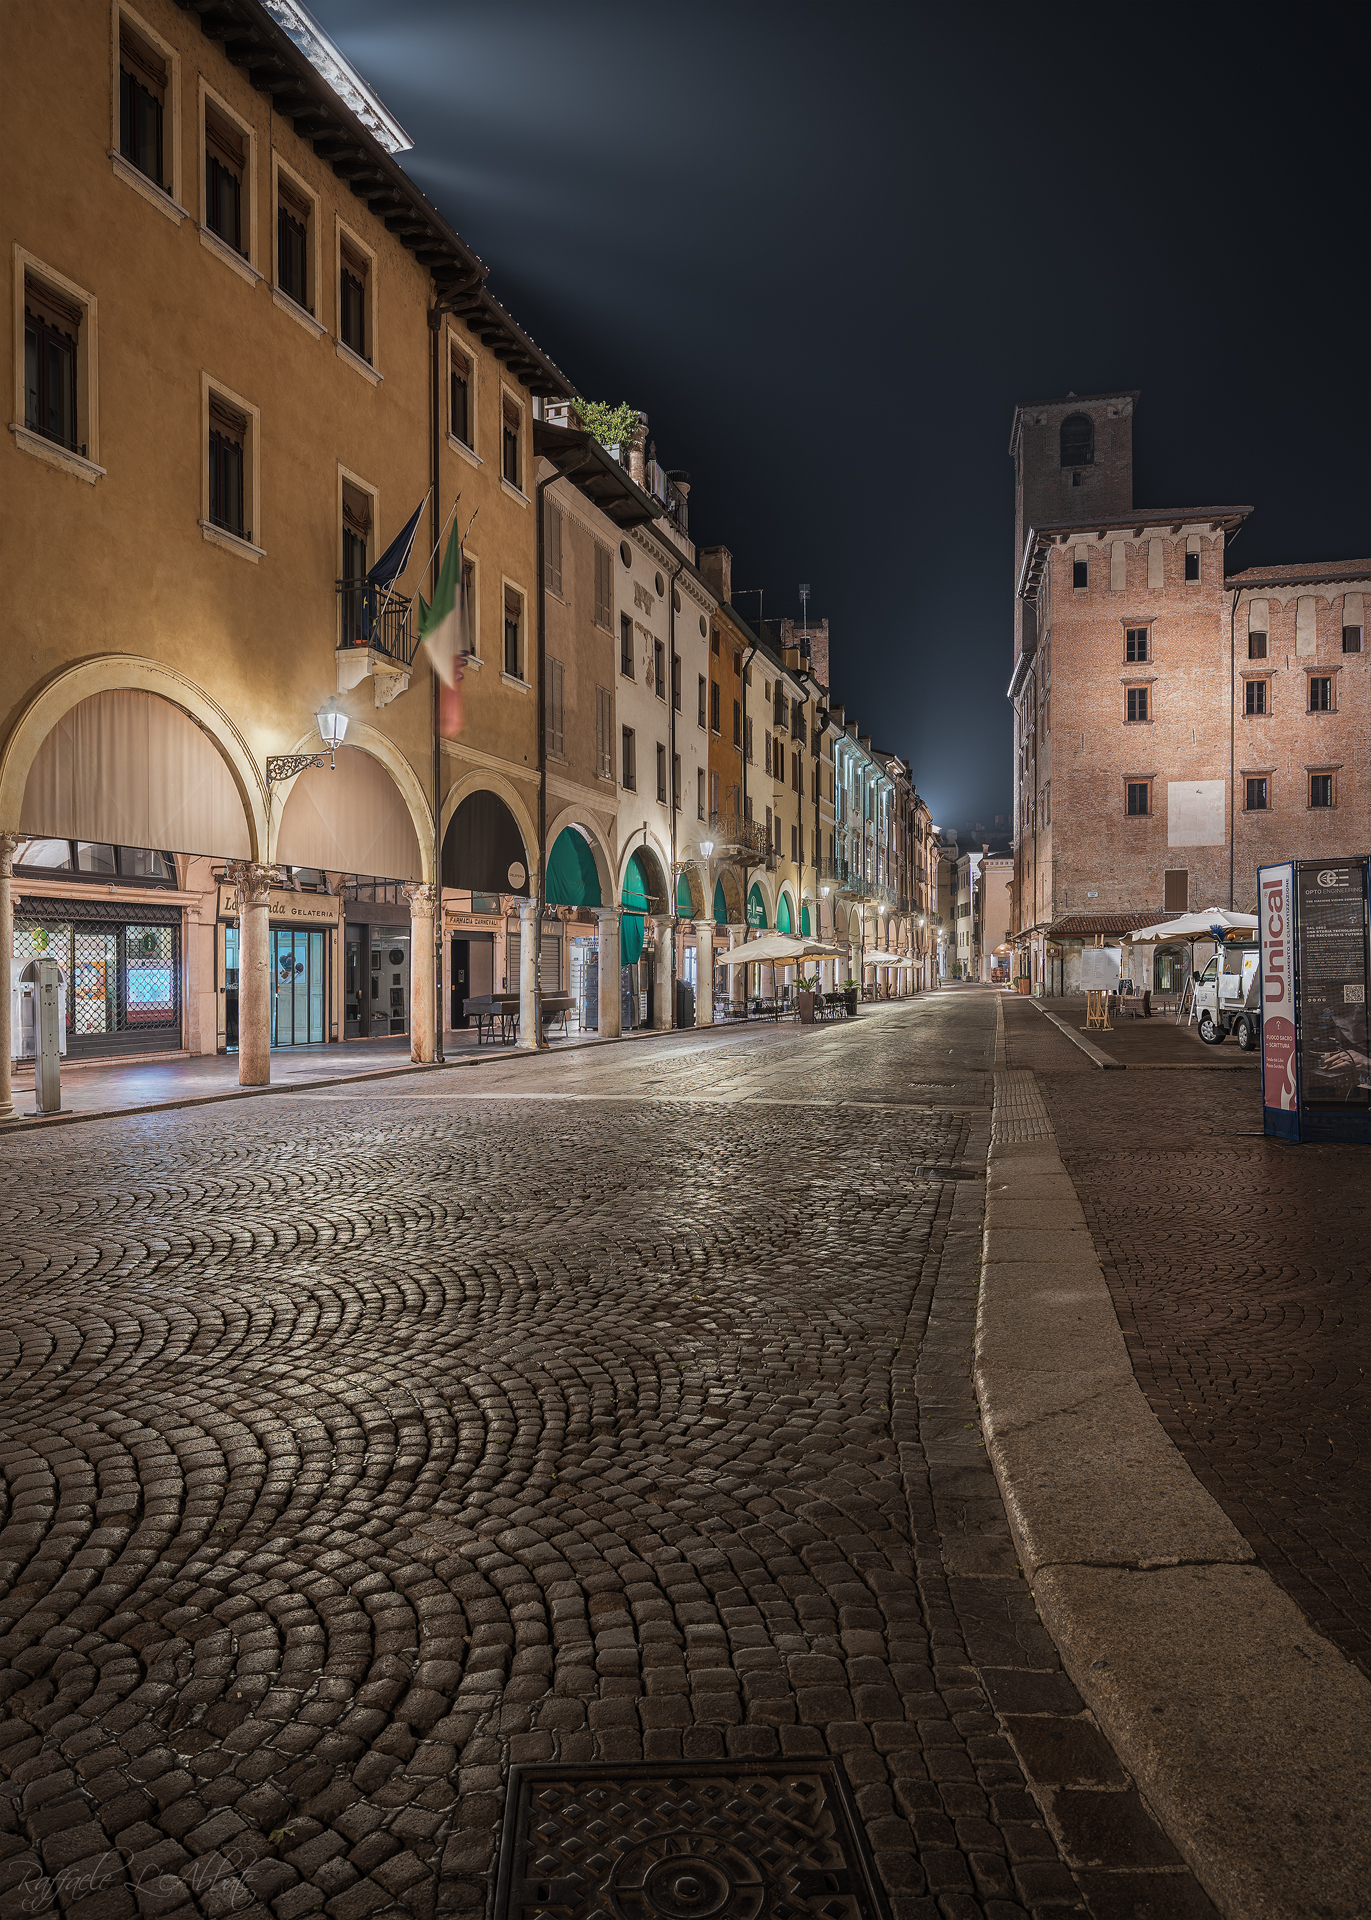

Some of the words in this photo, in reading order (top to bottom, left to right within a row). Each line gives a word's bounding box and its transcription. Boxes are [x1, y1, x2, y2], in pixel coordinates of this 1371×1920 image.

[1322, 886, 1363, 894] ENGINEERING
[291, 907, 334, 918] GELATERIA
[1262, 879, 1285, 1003] Unical
[646, 1838, 725, 1859] CAVI
